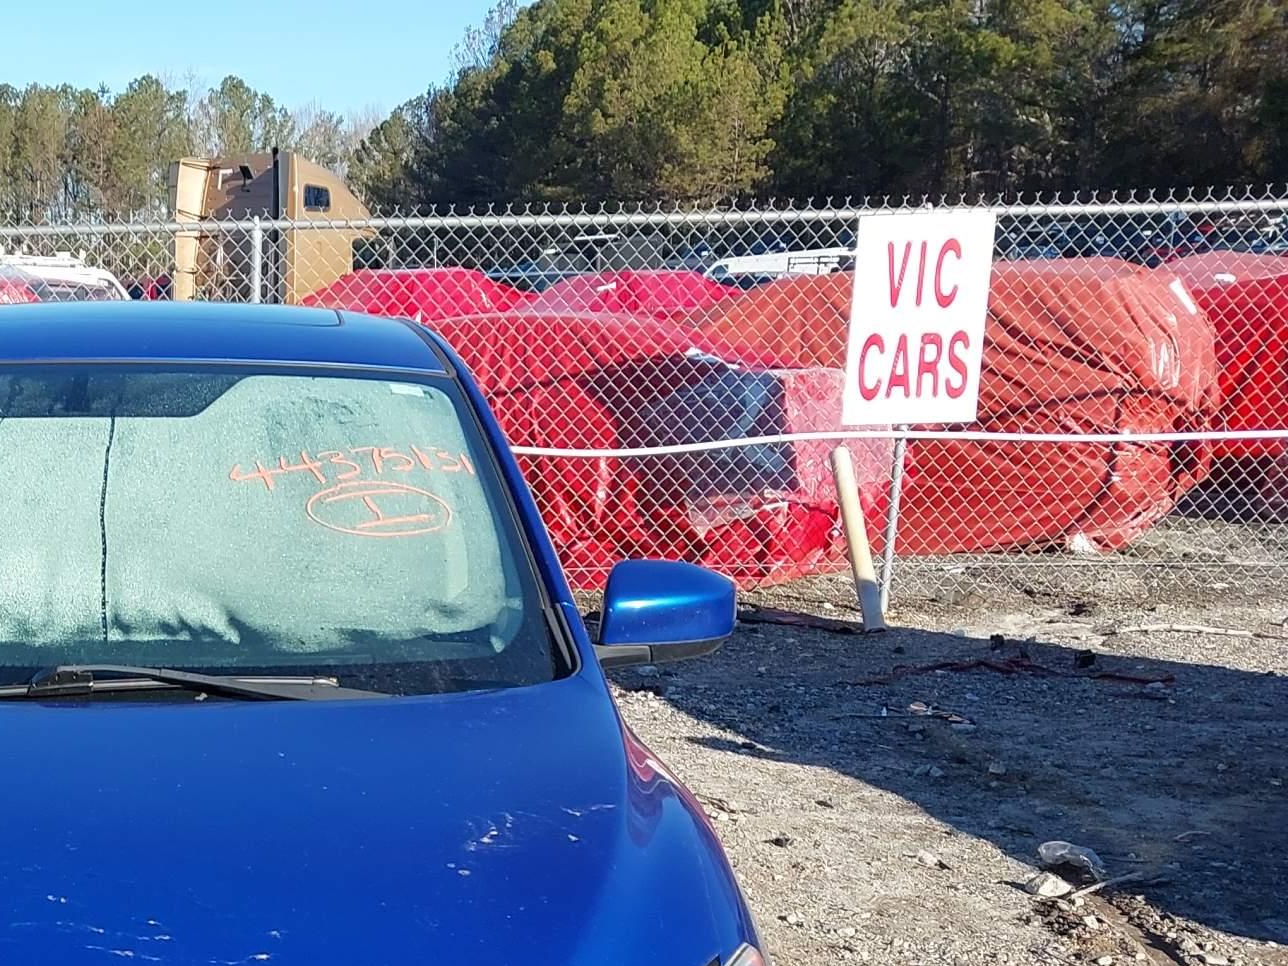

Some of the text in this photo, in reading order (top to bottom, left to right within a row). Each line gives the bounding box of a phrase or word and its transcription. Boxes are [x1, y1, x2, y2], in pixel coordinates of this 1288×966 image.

[887, 238, 962, 309] VIC
[858, 330, 970, 401] CARS
[229, 444, 475, 491] 44375131
